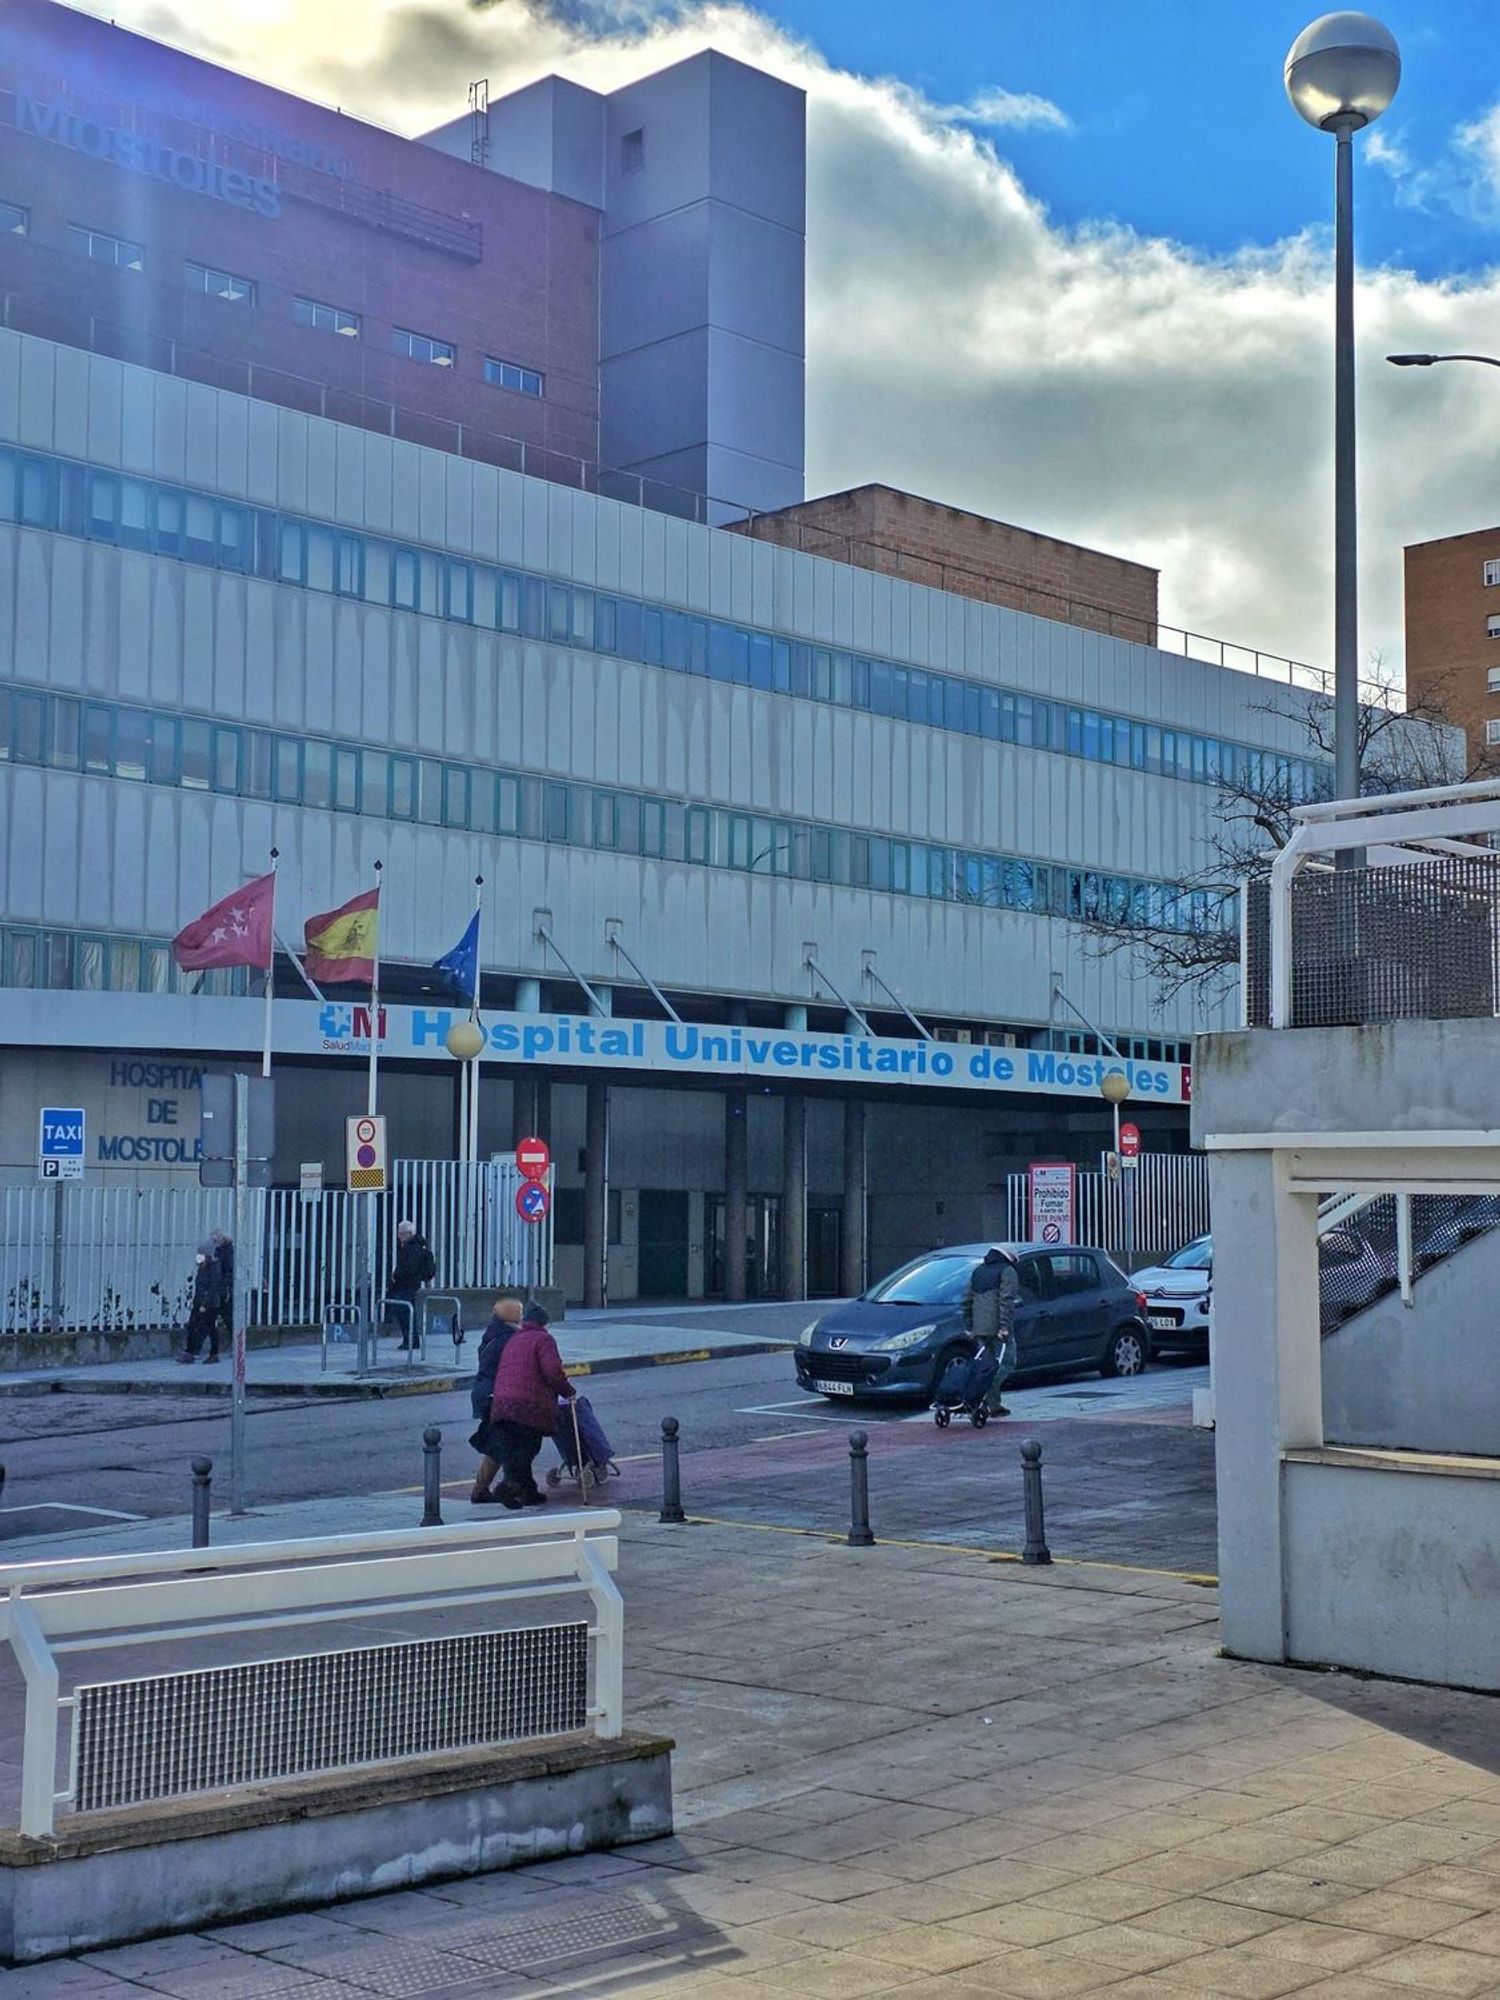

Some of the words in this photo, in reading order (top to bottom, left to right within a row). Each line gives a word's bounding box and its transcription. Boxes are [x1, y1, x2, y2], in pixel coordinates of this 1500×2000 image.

[412, 1010, 644, 1058] Hspital
[665, 1026, 953, 1076] Universitario
[969, 1048, 1014, 1080] de
[110, 1061, 207, 1090] HOSPITA
[147, 1098, 178, 1124] DE
[44, 1125, 82, 1140] TAXI
[98, 1135, 203, 1163] MOSTOLE
[46, 1162, 56, 1176] P
[1034, 1187, 1069, 1199] Prohibido
[1041, 1199, 1064, 1208] Fumar
